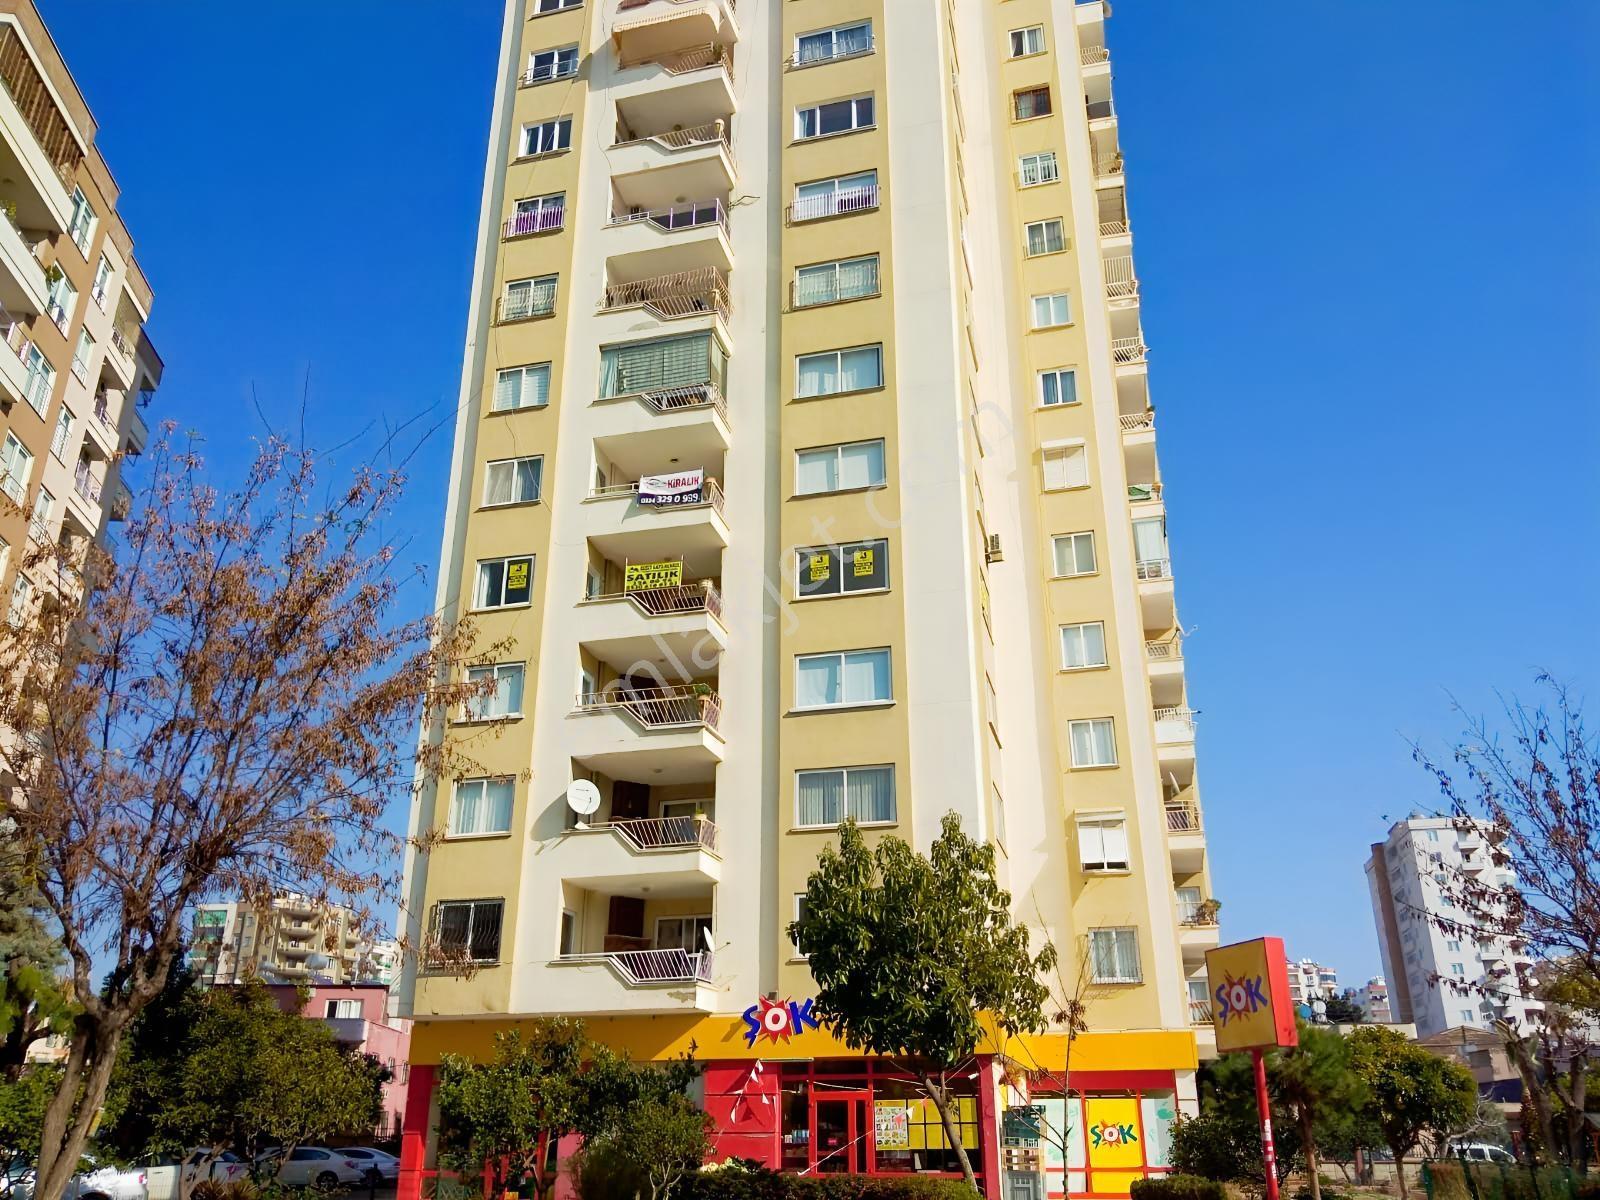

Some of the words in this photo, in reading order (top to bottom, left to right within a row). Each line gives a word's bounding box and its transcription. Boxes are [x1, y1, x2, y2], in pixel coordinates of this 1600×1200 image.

[626, 570, 679, 582] SATILIK
[742, 997, 819, 1050] ŞOK
[1216, 974, 1268, 1028] ŞOK
